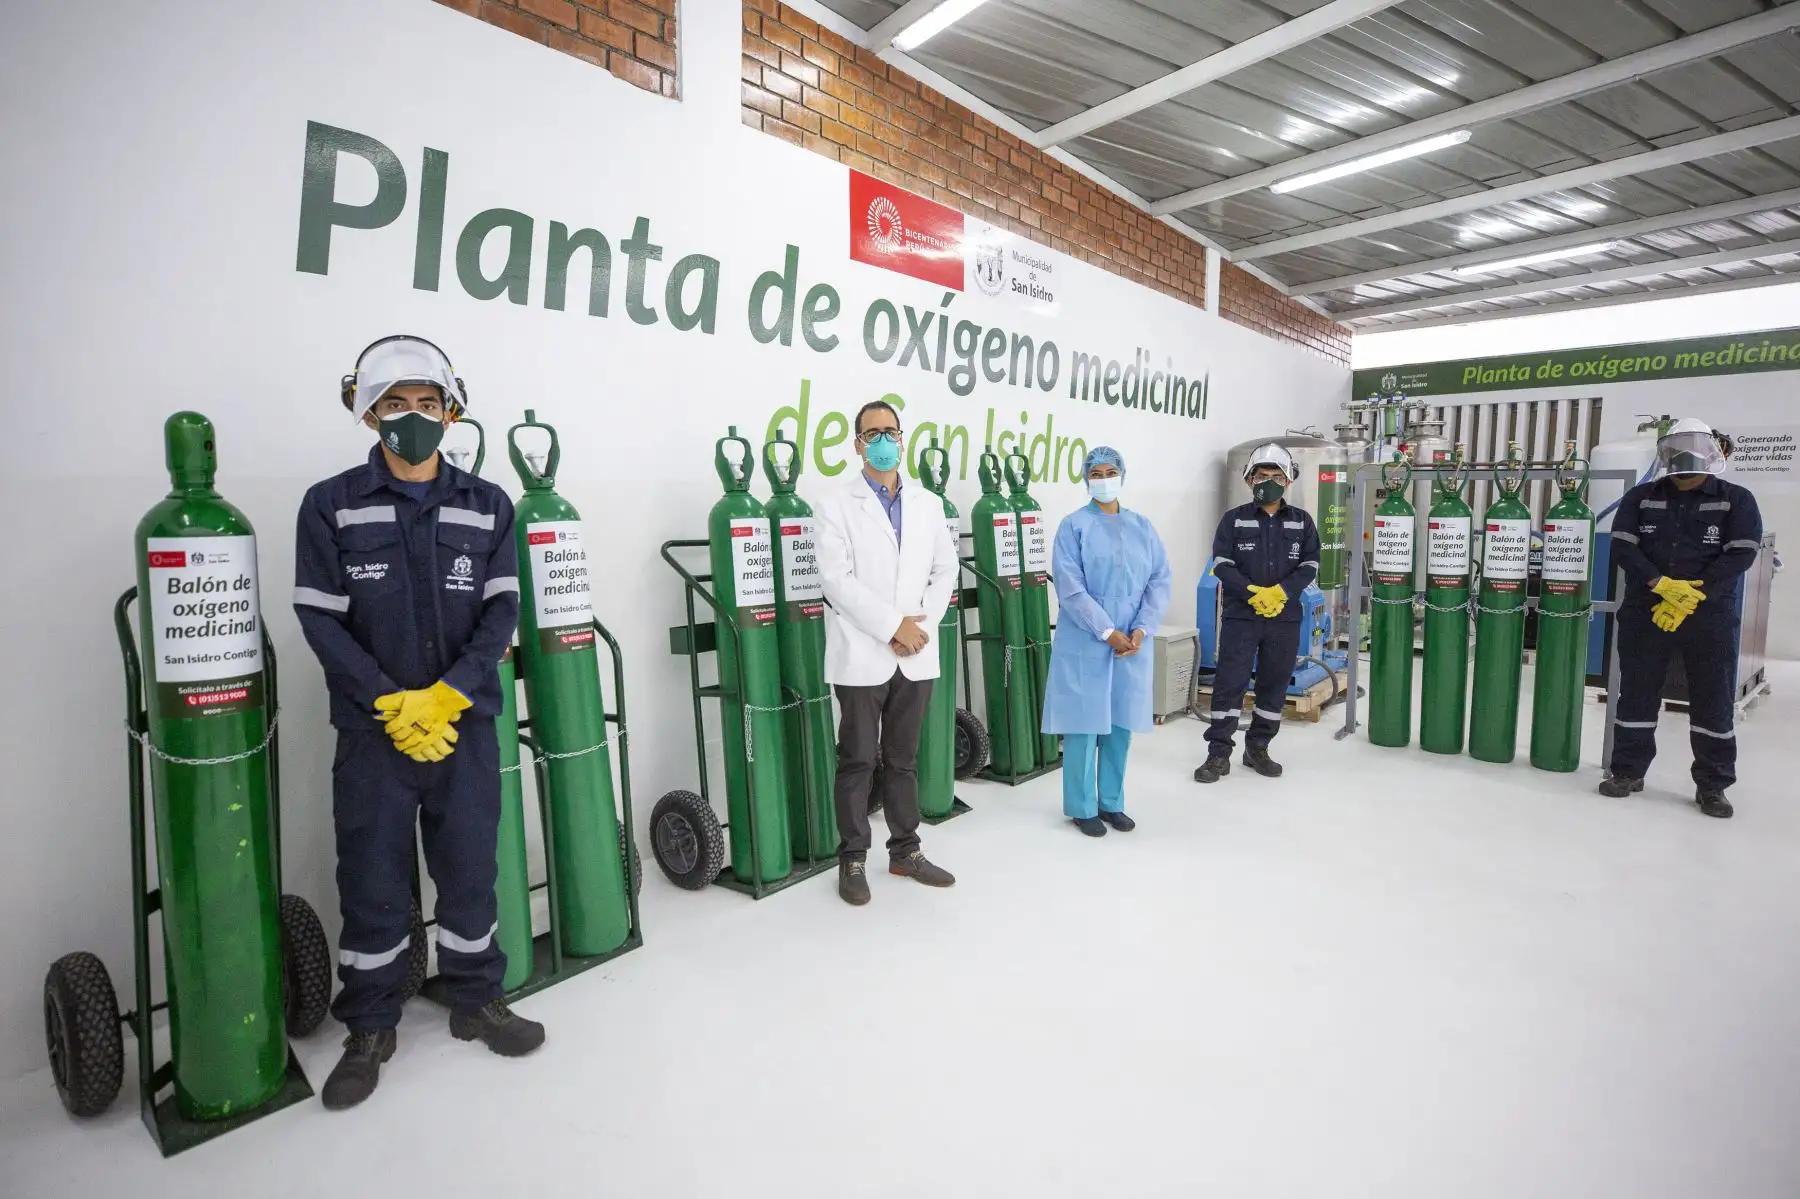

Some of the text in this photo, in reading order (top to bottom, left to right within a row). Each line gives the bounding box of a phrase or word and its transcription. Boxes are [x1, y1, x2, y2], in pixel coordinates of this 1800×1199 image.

[1012, 249, 1052, 274] Municipalidad
[296, 119, 1210, 420] Planta de oxígeno medicinal
[1029, 271, 1037, 281] de
[1011, 277, 1054, 303] San Isidro
[1463, 365, 1530, 385] Planta
[1536, 359, 1564, 379] de
[1570, 353, 1667, 378] oxígeno
[766, 378, 849, 477] de
[985, 408, 1088, 484] Isidro
[1737, 434, 1793, 444] Generando
[1732, 444, 1797, 454] oxígeno para
[1734, 453, 1793, 462] salvar vidas
[1377, 530, 1409, 539] Balón de
[1432, 532, 1465, 541] Balón de
[1491, 535, 1526, 544] Balón de
[1547, 535, 1584, 544] Balón de
[743, 542, 768, 553] Balón
[1320, 542, 1332, 550] San
[1378, 540, 1408, 549] oxígeno
[1433, 541, 1464, 551] oxígeno
[1492, 545, 1524, 554] oxígeno
[1430, 550, 1467, 559] medicinal
[1548, 545, 1582, 555] oxígeno
[544, 549, 579, 563] Balón
[1488, 553, 1526, 562] medicinal
[1545, 554, 1585, 563] medicinal
[346, 563, 389, 574] San Isidro
[351, 571, 386, 580] Contigo
[167, 573, 251, 595] Balón de
[173, 598, 249, 619] oxígeno
[544, 607, 559, 615] San
[560, 605, 580, 613] Isidro
[165, 615, 256, 639] medicinal
[164, 648, 258, 665] San Isidro Contigo
